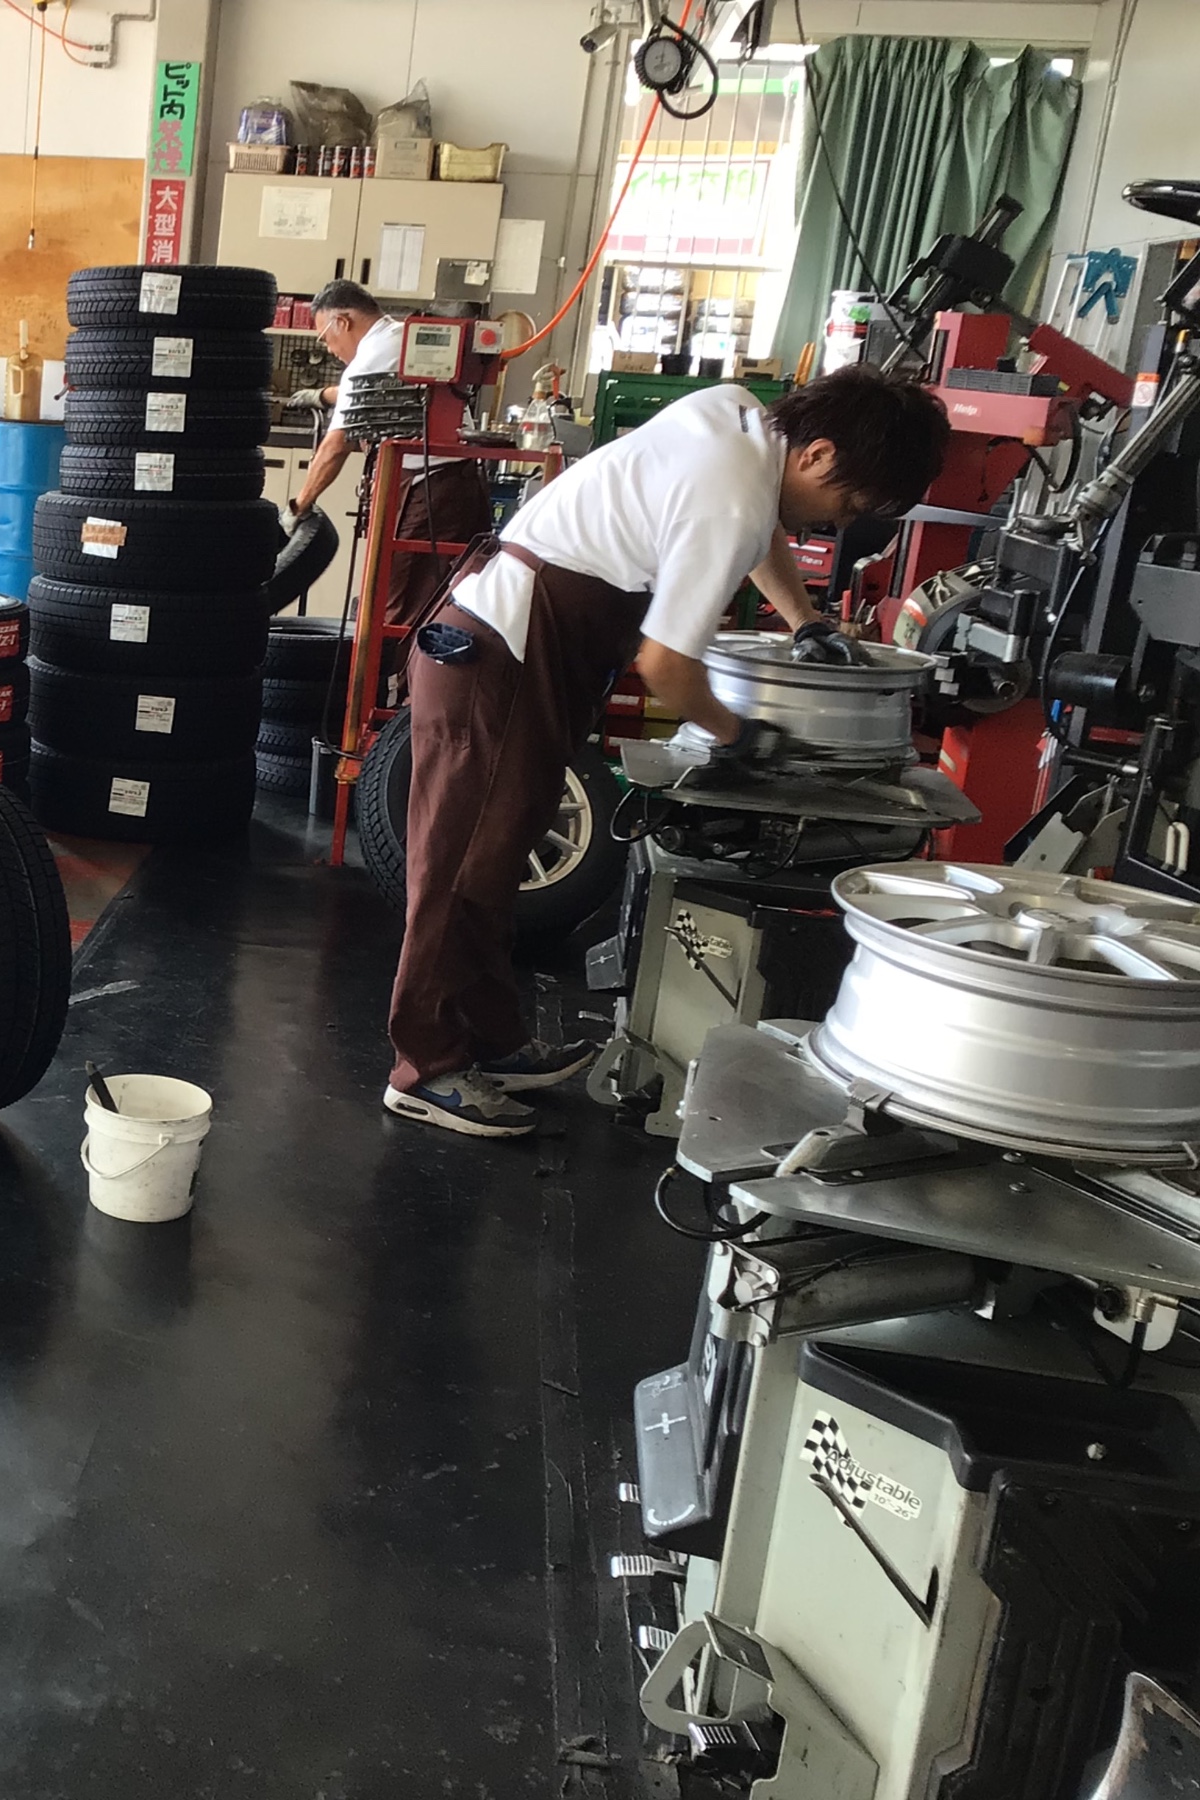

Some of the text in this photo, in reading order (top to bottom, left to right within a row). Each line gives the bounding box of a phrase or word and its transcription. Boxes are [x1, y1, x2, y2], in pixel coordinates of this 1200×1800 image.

[152, 62, 192, 174] ピット内禁煙
[825, 1450, 921, 1510] Adjustable
